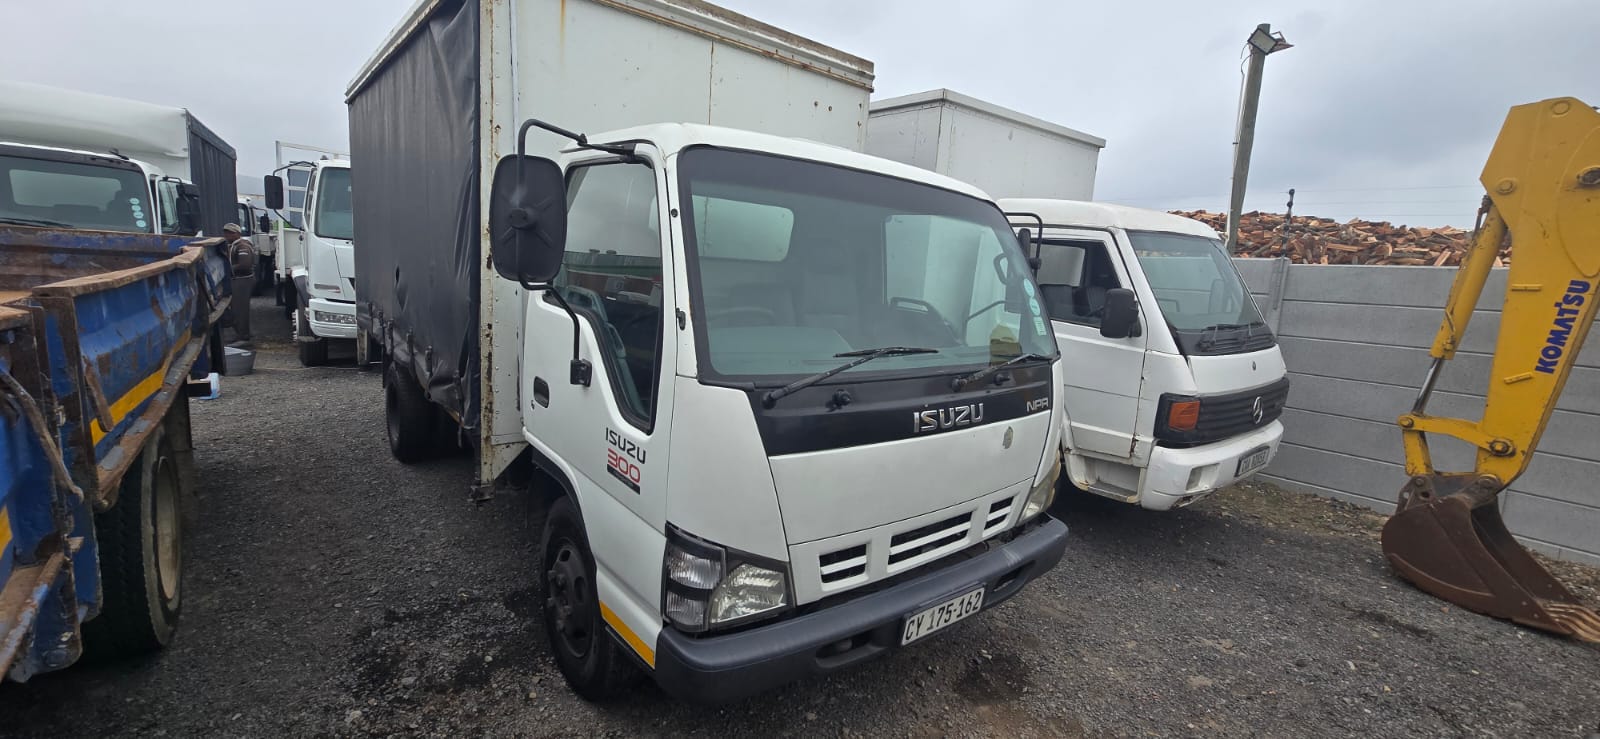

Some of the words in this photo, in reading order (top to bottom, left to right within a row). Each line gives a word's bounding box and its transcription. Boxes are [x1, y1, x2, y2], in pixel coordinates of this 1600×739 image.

[1534, 279, 1591, 374] KOMATSU
[913, 403, 984, 433] ISUZU
[1026, 397, 1049, 412] NPR
[605, 427, 646, 464] ISUZU
[608, 448, 641, 483] 300
[905, 614, 925, 640] CY
[926, 591, 982, 631] 175-162
